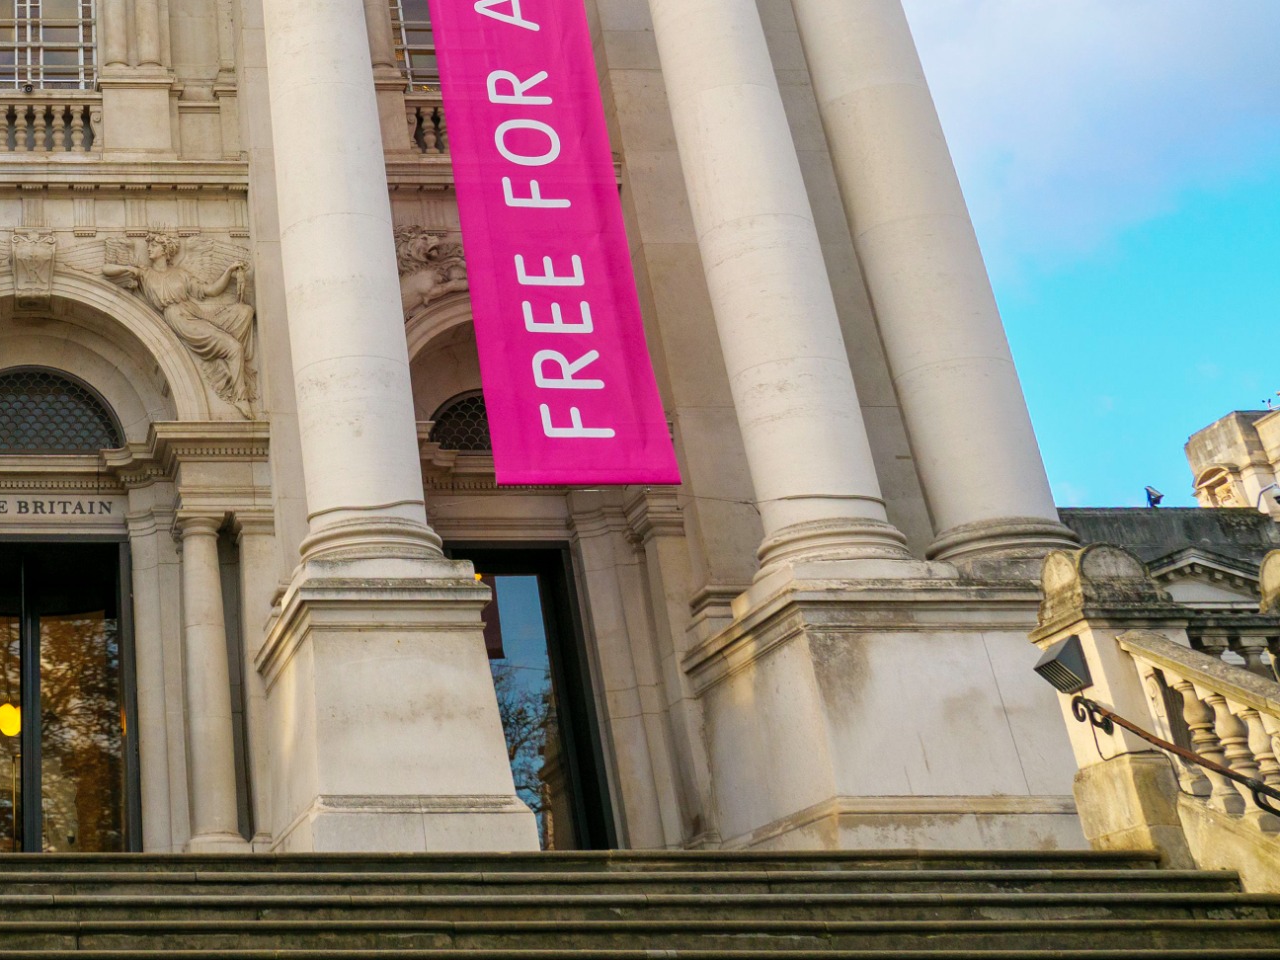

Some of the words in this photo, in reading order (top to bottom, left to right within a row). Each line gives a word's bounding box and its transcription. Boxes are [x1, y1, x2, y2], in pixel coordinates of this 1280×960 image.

[486, 69, 561, 209] FOR
[513, 253, 616, 439] FREE
[16, 500, 113, 515] BRITAIN
